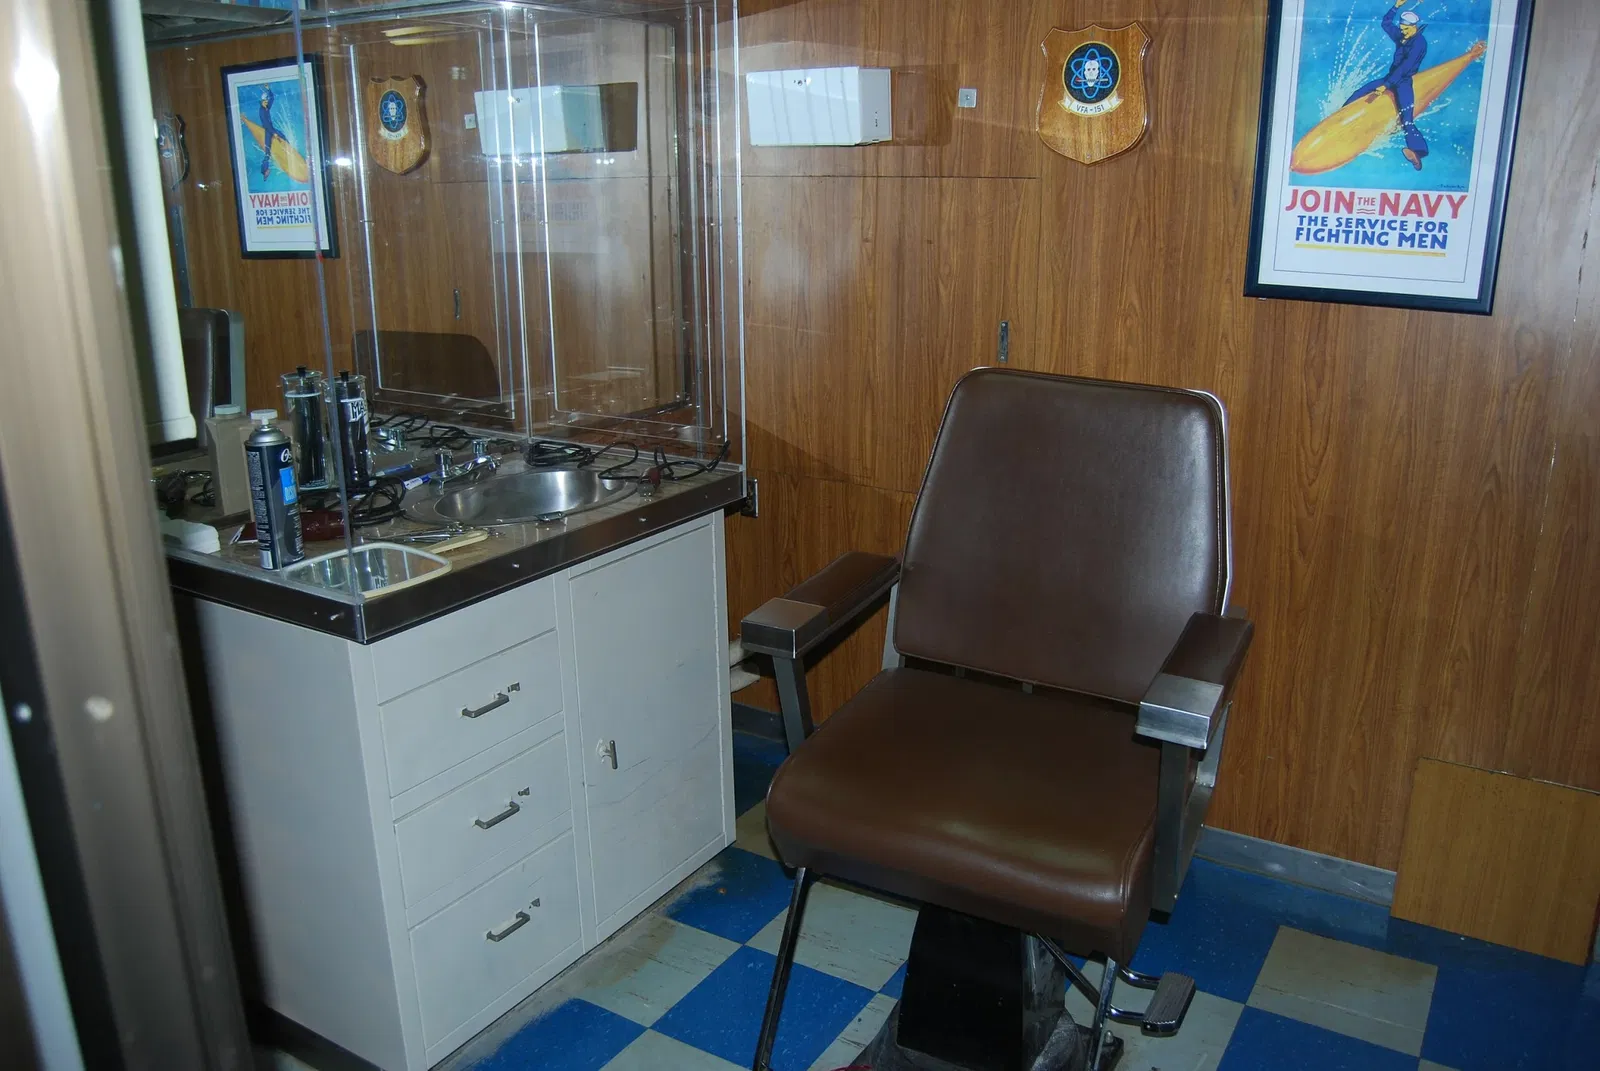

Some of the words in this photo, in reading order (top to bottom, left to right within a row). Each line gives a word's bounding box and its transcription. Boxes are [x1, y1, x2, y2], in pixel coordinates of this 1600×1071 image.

[1076, 104, 1105, 113] VFA-151
[1285, 188, 1355, 215] JOIN
[1357, 196, 1376, 206] THE
[1378, 192, 1469, 220] NAVY
[1297, 215, 1329, 228] THE
[1335, 217, 1408, 232] SERVICE
[1415, 221, 1449, 234] FOR
[1295, 227, 1389, 247] FIGHTING
[1397, 232, 1448, 250] MEN
